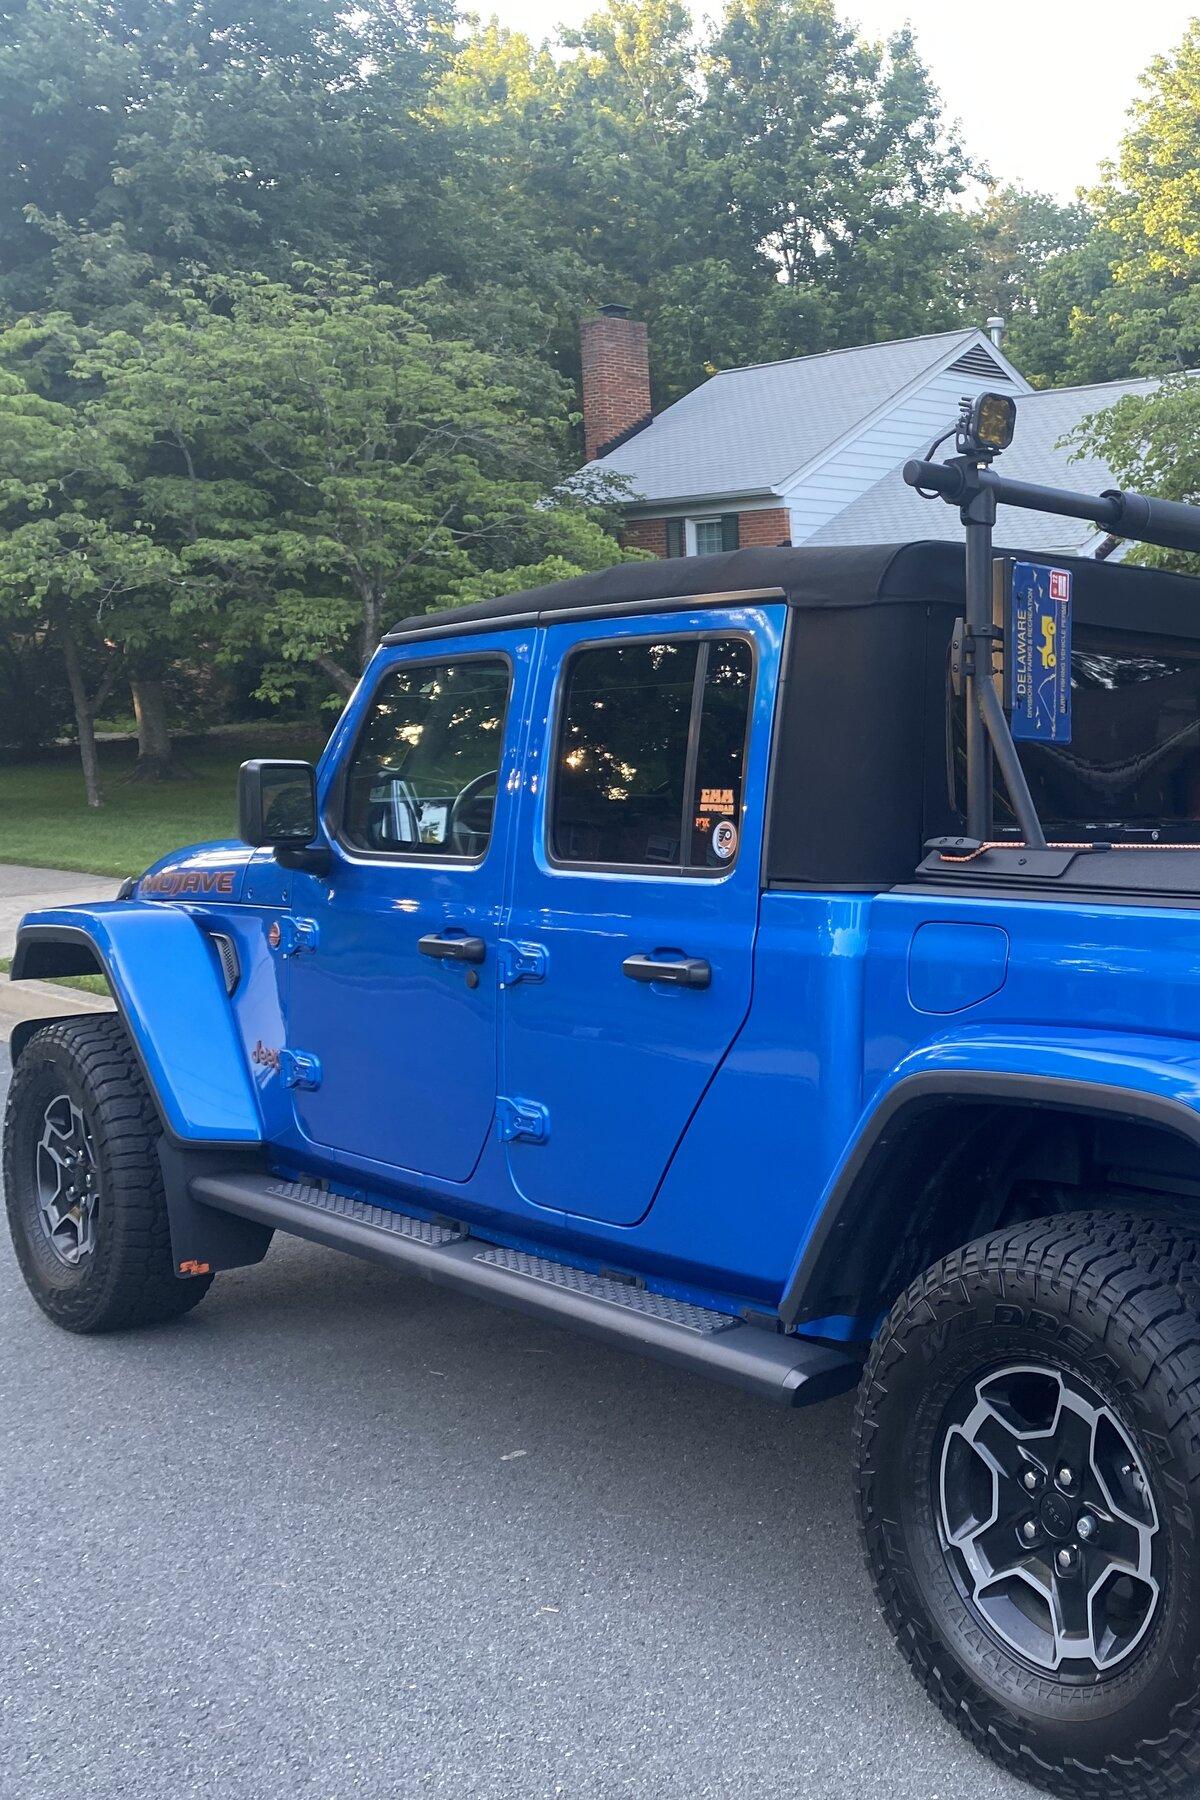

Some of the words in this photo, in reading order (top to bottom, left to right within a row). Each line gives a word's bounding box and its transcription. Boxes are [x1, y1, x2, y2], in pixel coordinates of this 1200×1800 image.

[1017, 610, 1026, 695] DELAWARE
[1027, 673, 1033, 684] OF
[139, 871, 236, 896] MOJAVE
